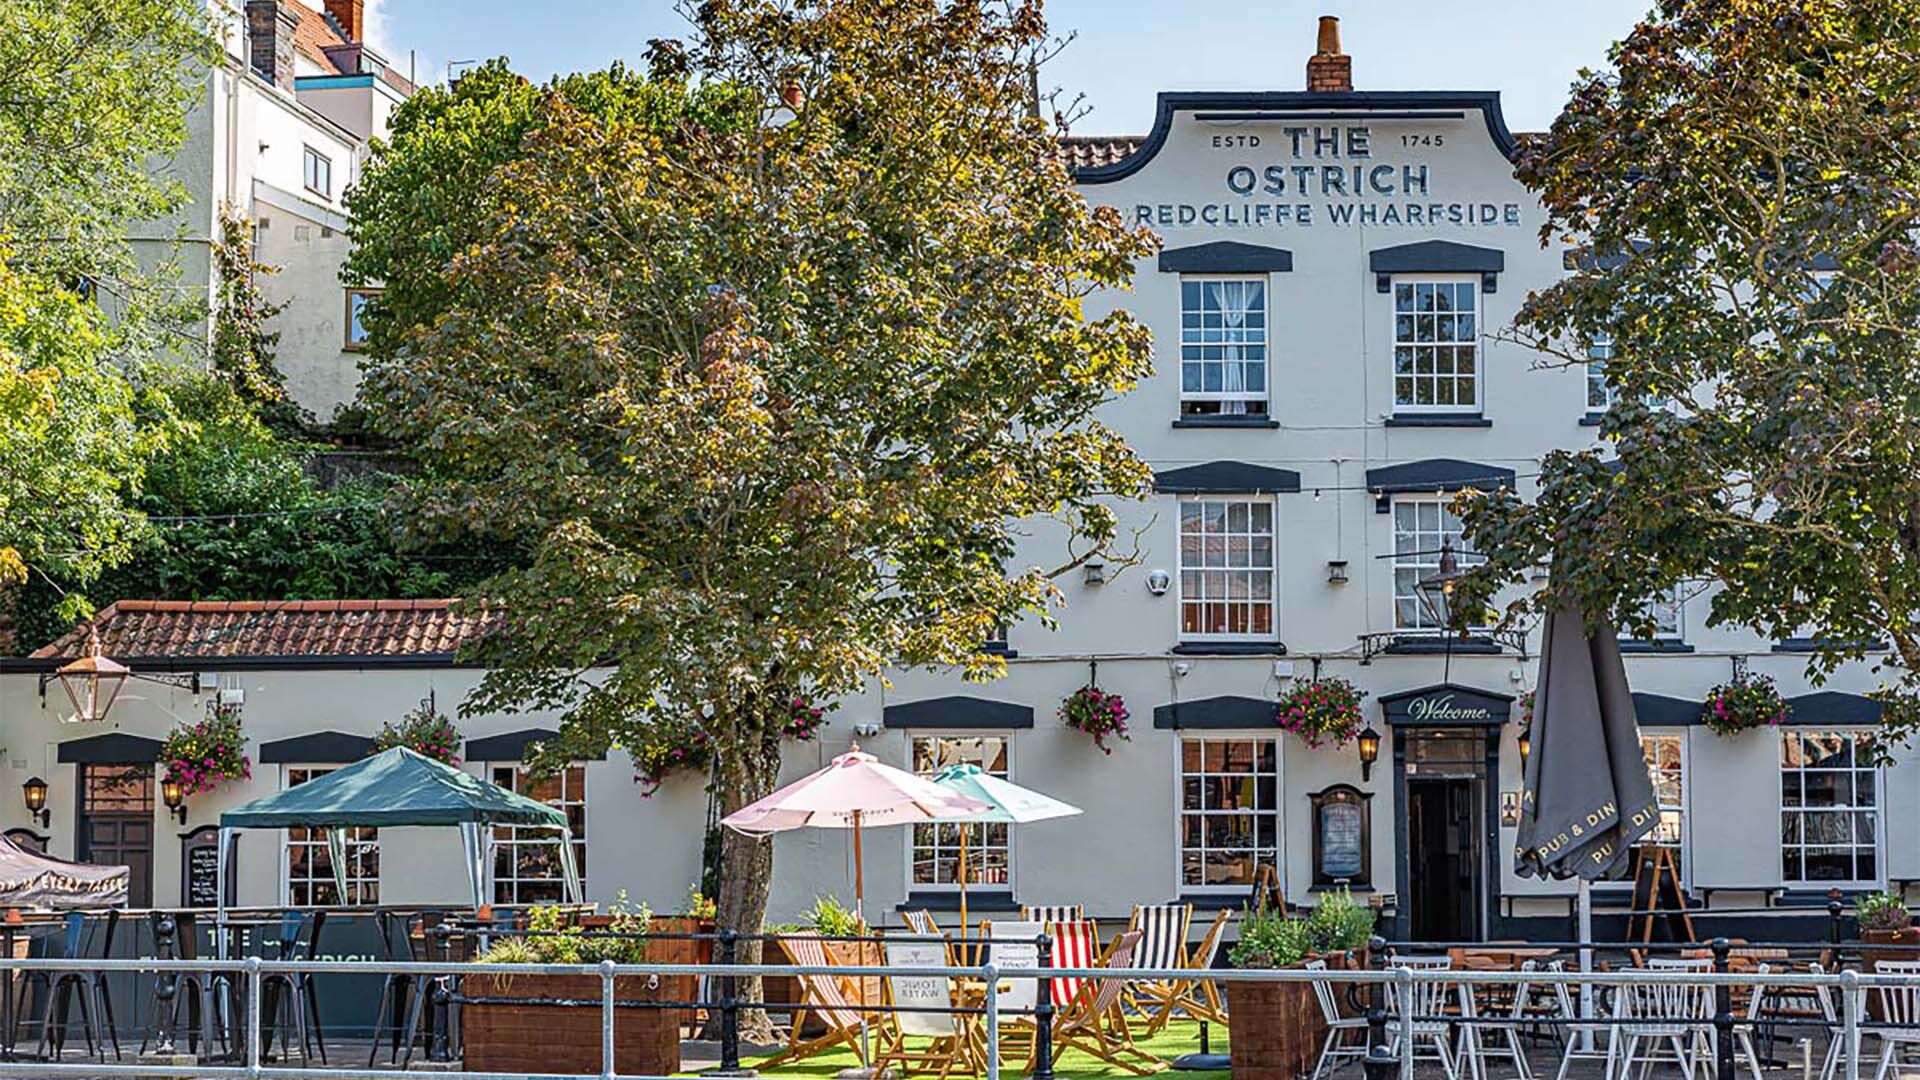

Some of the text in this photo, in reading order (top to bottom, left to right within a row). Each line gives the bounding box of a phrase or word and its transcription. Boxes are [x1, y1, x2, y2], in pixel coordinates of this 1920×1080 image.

[1212, 136, 1261, 148] ESTD
[1283, 127, 1371, 158] THE
[1400, 135, 1444, 147] 1745
[1227, 165, 1430, 196] OSTRICH
[1136, 203, 1521, 227] REDCLIFFE WHARFSIDE
[1538, 832, 1569, 859] PUB
[1571, 823, 1585, 838] &
[1592, 842, 1614, 865] PU
